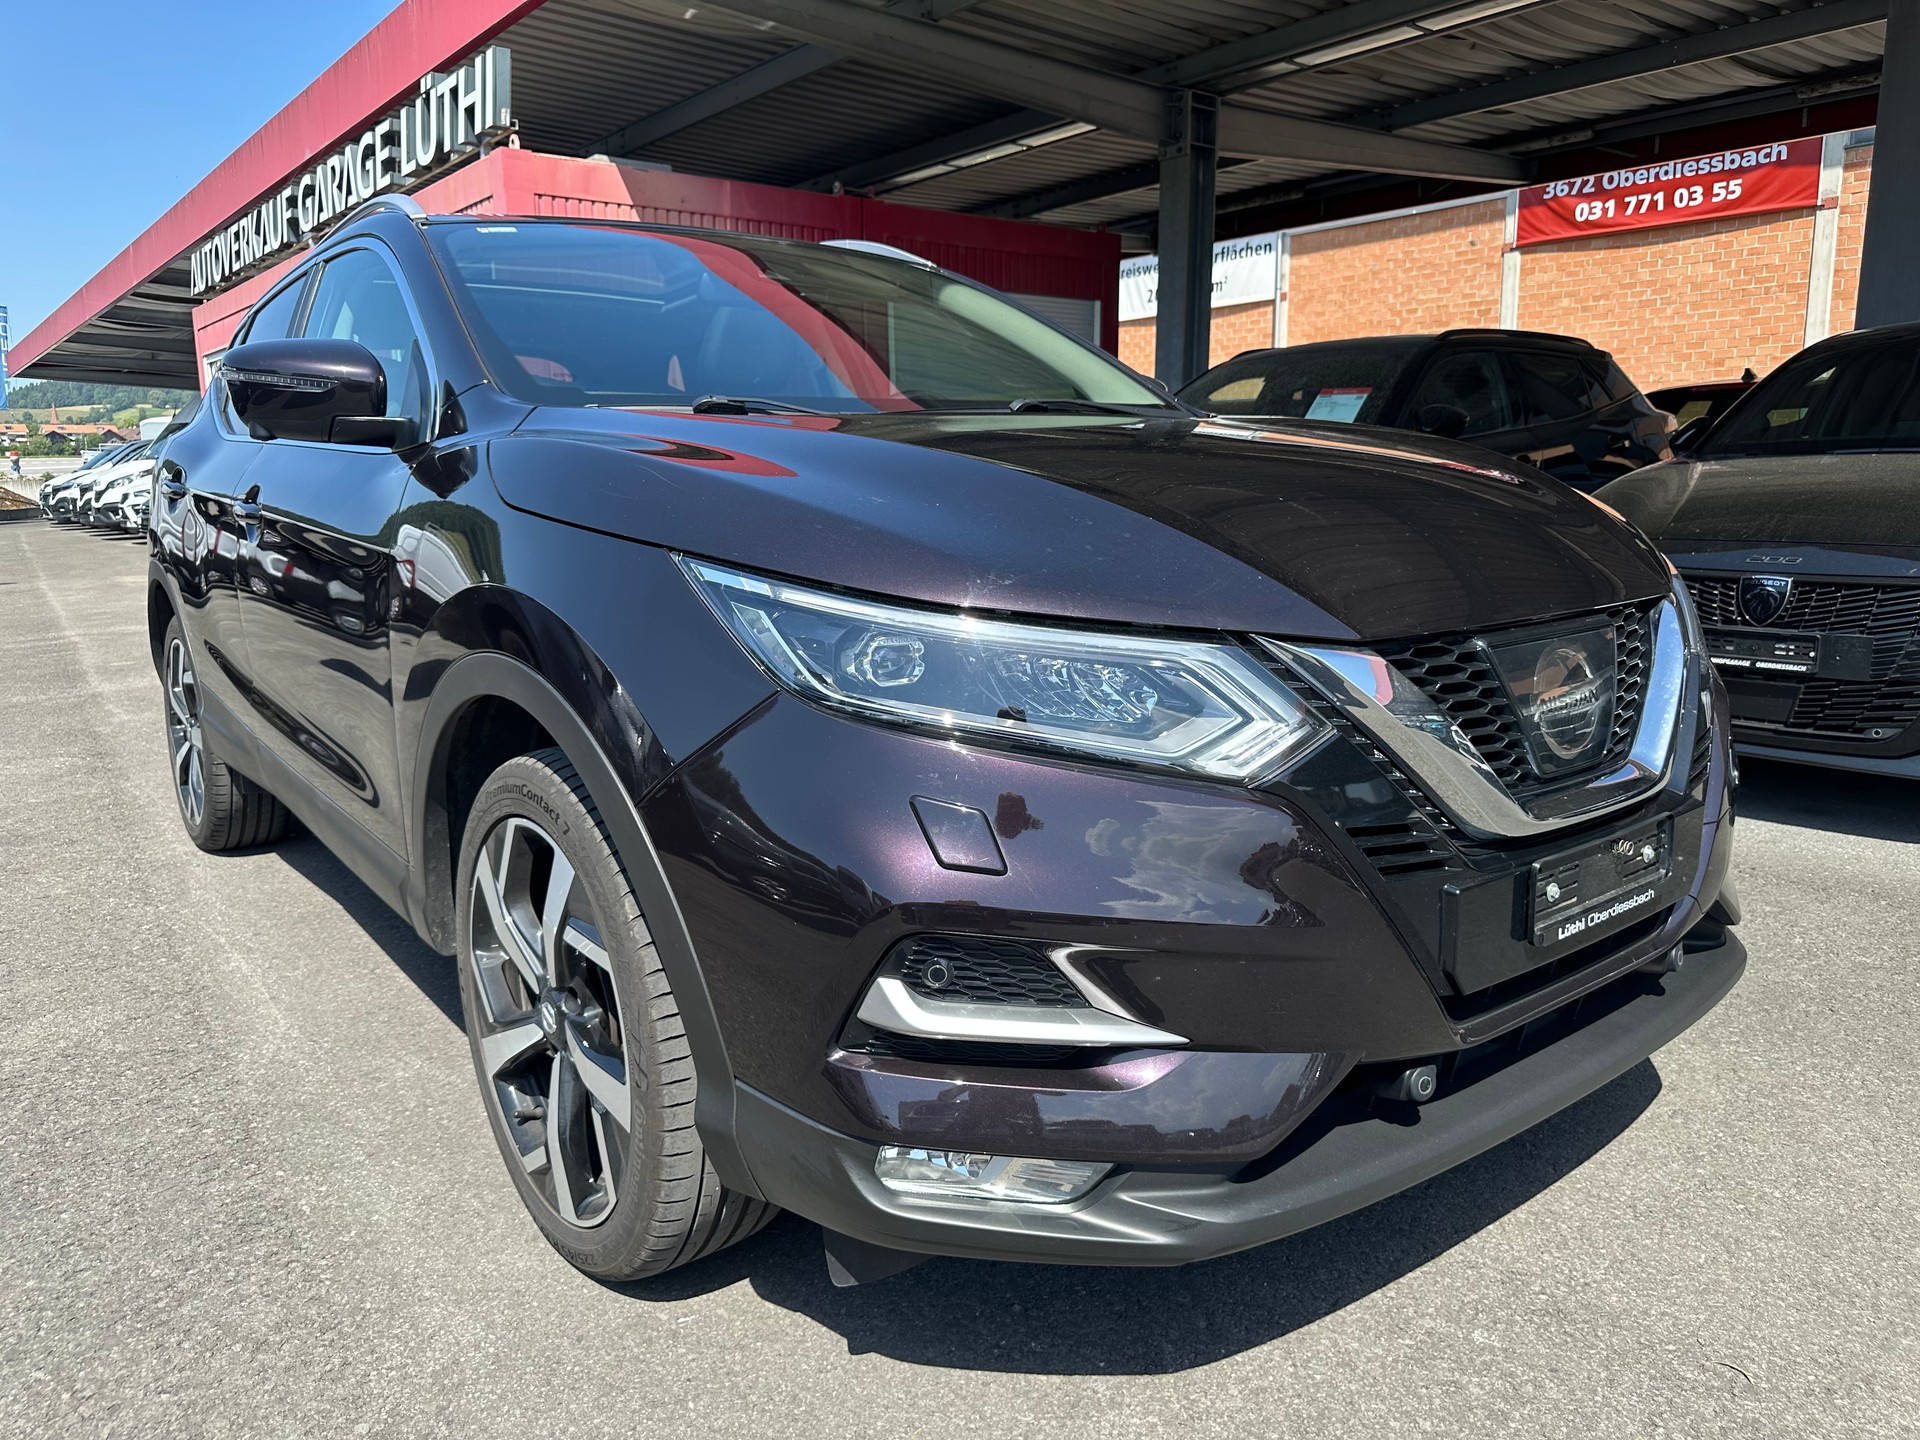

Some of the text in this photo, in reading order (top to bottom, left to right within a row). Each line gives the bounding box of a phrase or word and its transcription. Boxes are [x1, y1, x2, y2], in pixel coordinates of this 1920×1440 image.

[190, 46, 497, 297] AUTOVERKAUF GARAGE LÜTHI
[1543, 144, 1788, 200] 3672 Oberdiessbach
[1575, 178, 1743, 222] 031 771 03 55
[1744, 579, 1787, 587] PEUGEOT
[1755, 661, 1807, 672] OBERDIESSBACH
[1539, 688, 1599, 713] NISSAN
[485, 780, 571, 836] PremiumContact 7
[1587, 888, 1655, 927] Oberdiessbach
